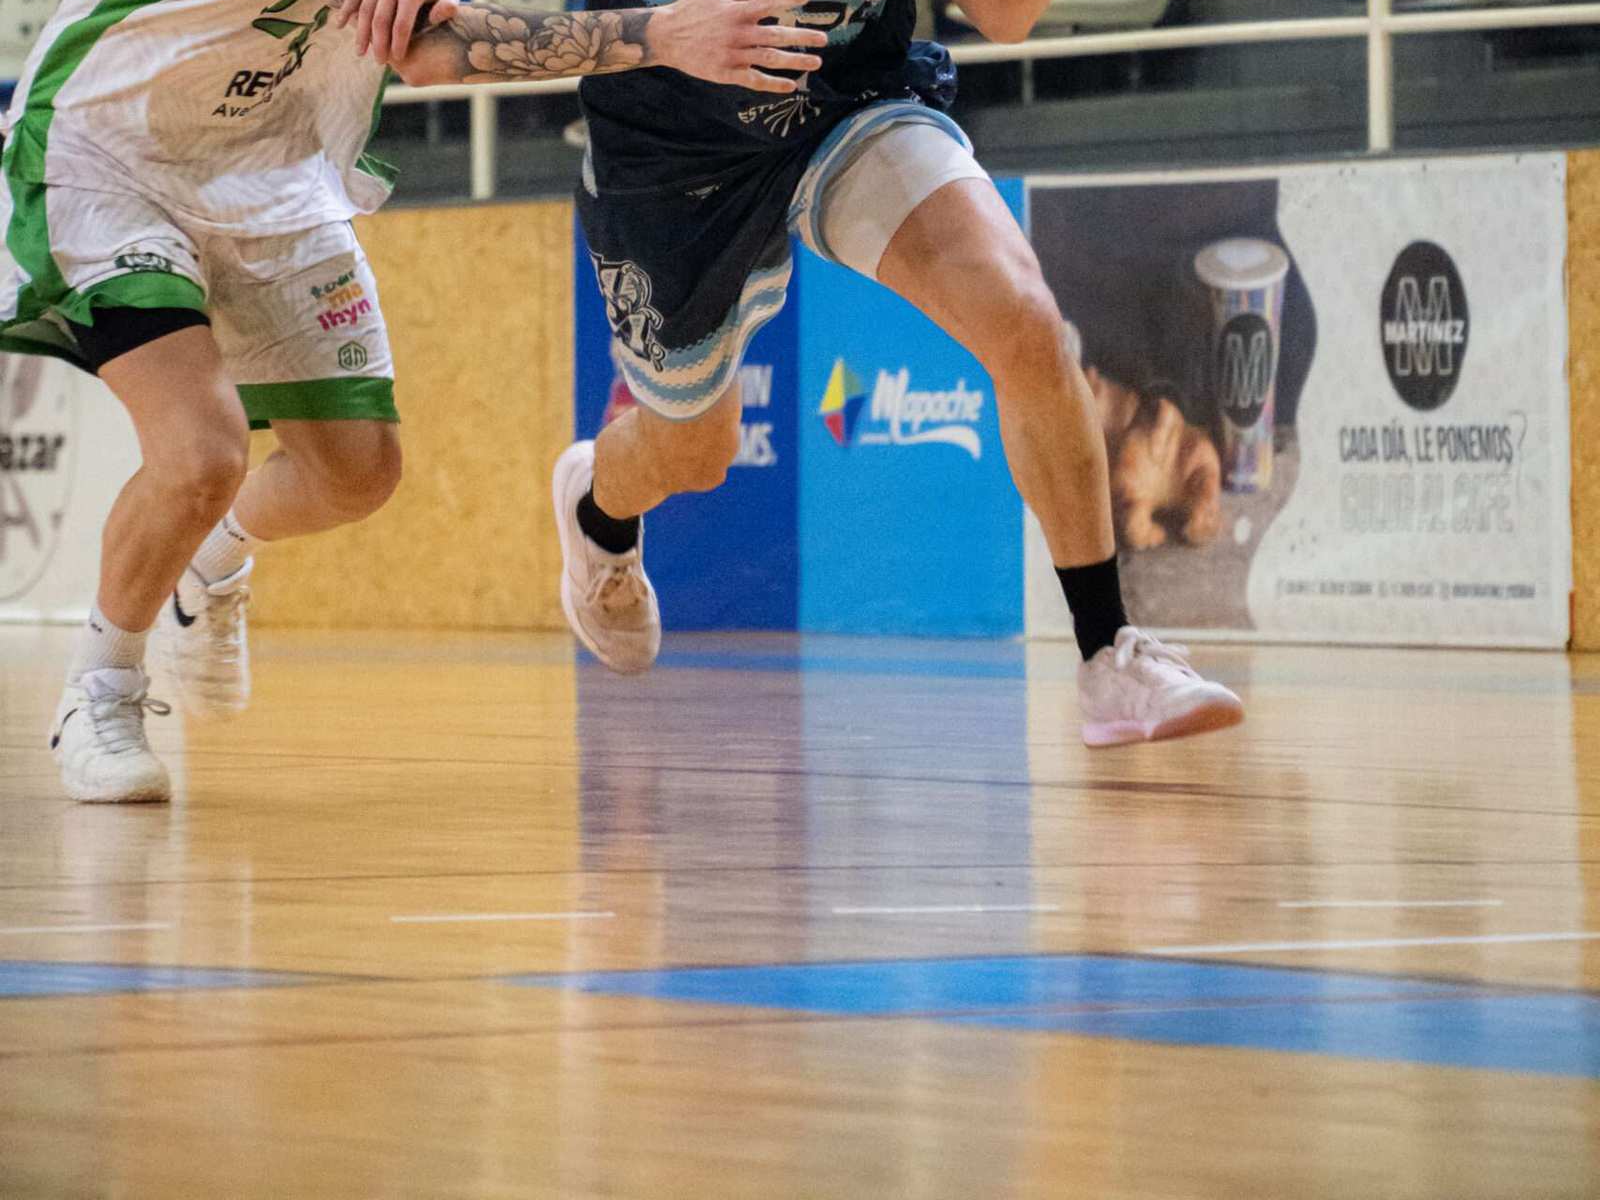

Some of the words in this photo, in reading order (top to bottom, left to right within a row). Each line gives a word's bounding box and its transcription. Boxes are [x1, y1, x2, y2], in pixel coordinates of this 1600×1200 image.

[1384, 319, 1465, 344] MARTINEZ
[1339, 425, 1377, 463] CADA
[1415, 425, 1435, 462] LE
[1436, 423, 1514, 465] PONEMOS
